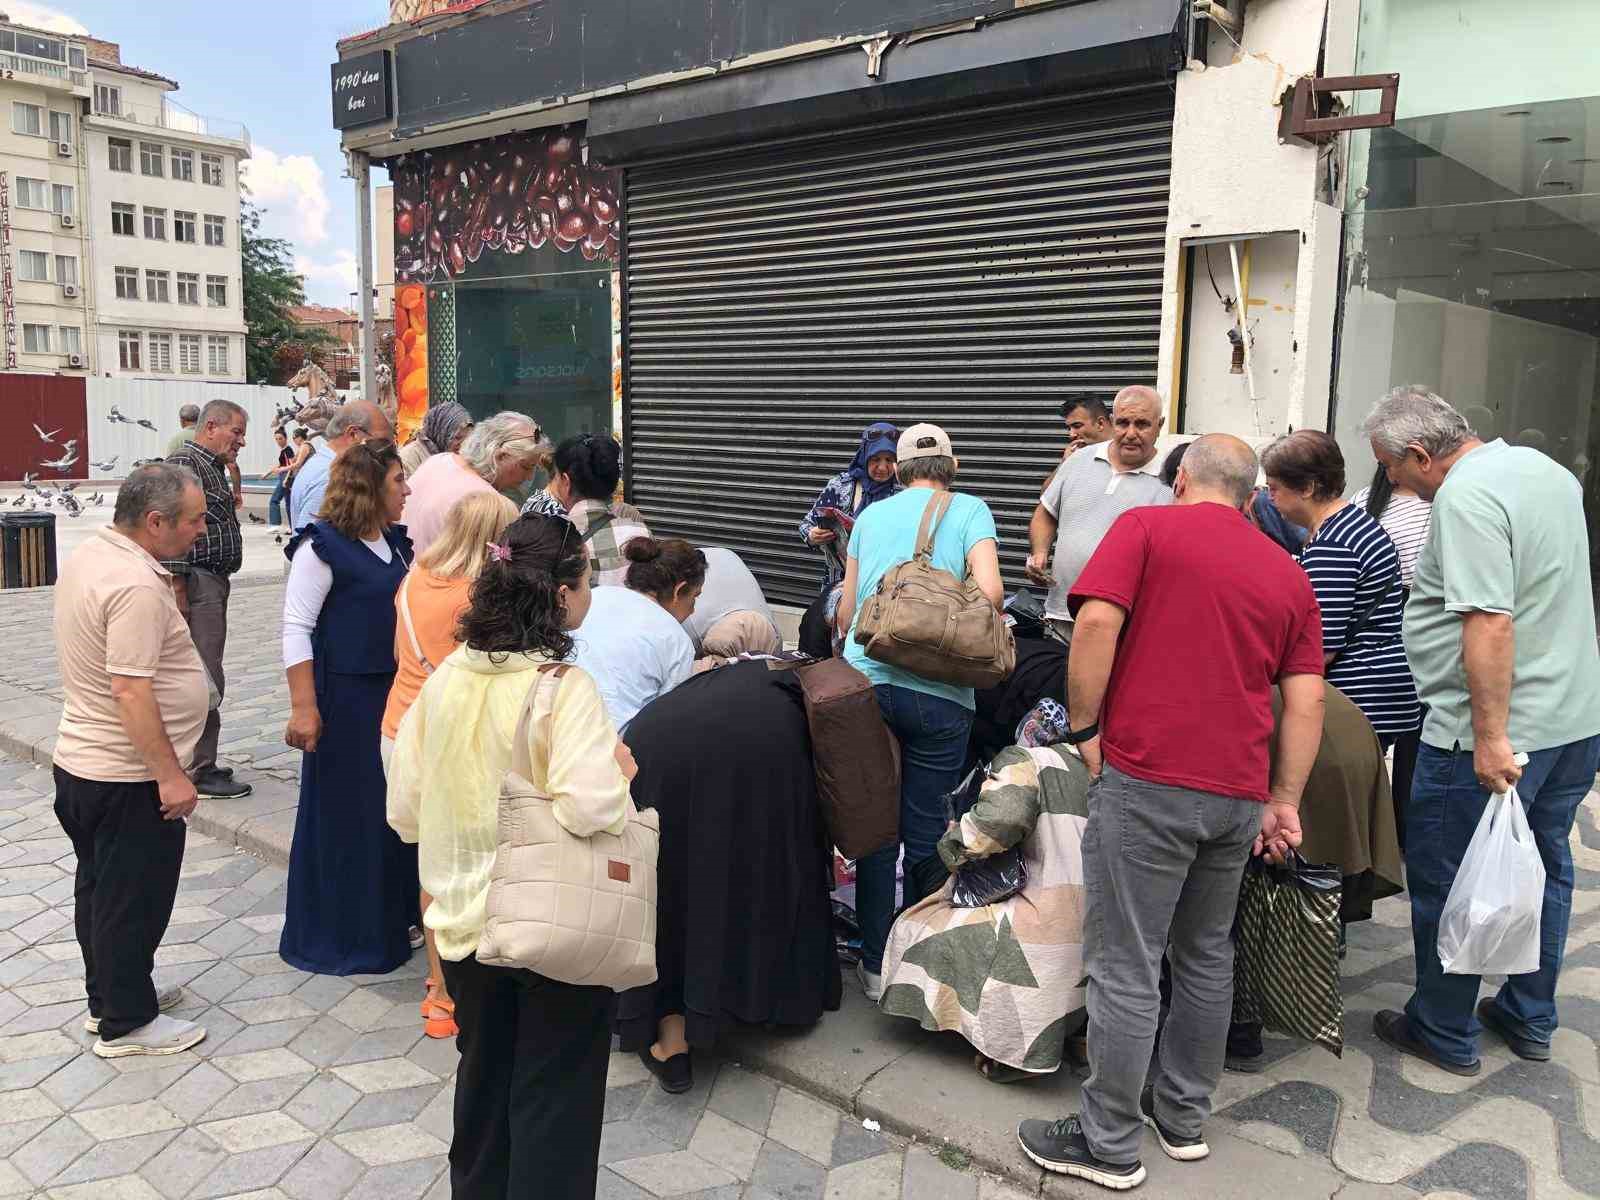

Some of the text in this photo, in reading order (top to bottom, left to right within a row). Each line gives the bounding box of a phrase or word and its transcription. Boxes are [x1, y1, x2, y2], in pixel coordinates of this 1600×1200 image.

[335, 70, 379, 92] 1990'dan
[348, 95, 366, 111] beri
[0, 174, 9, 243] OTEL
